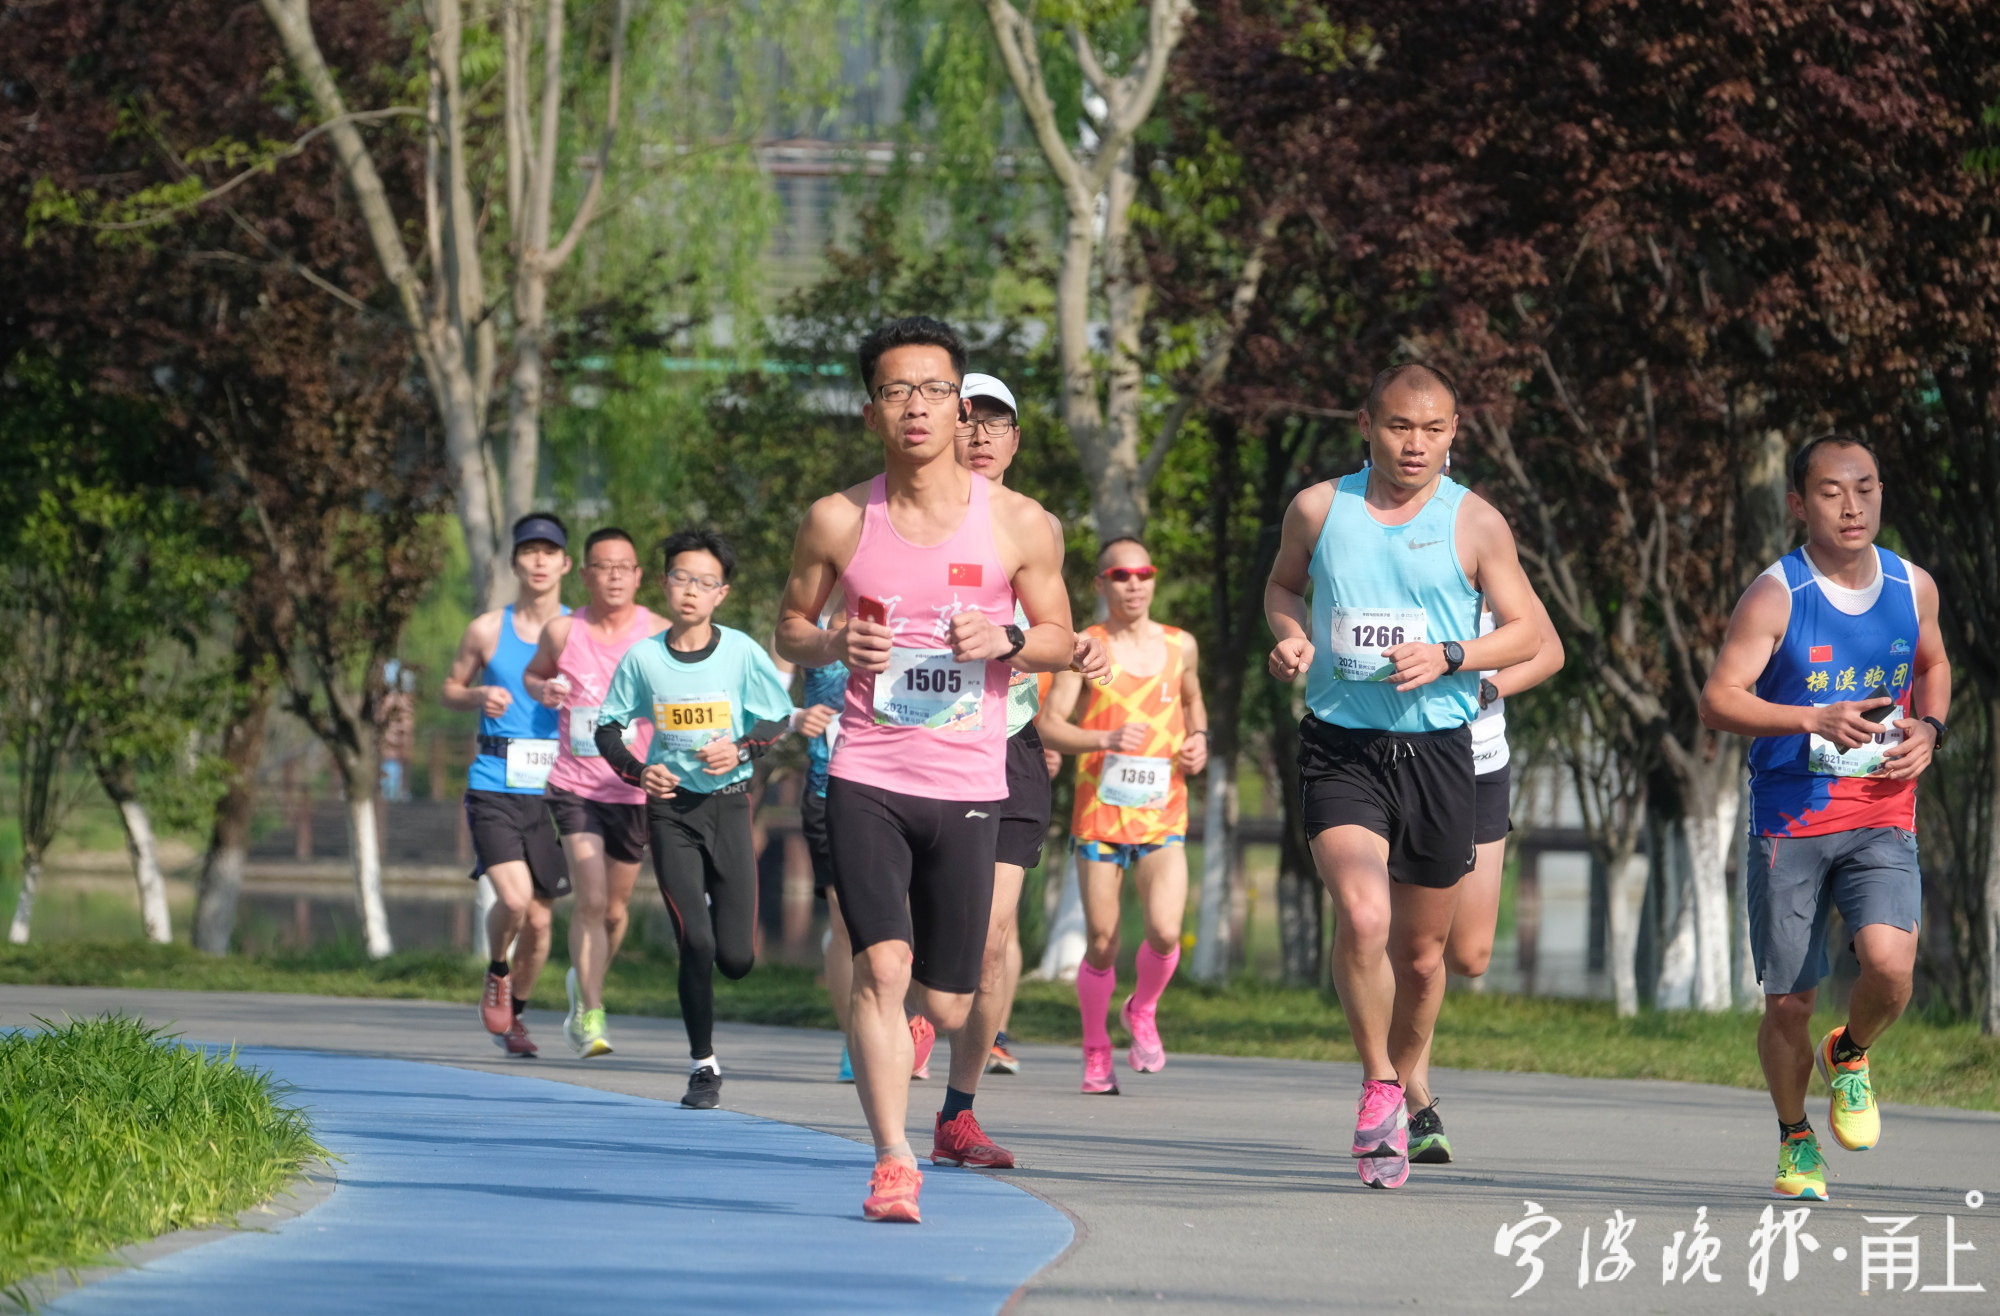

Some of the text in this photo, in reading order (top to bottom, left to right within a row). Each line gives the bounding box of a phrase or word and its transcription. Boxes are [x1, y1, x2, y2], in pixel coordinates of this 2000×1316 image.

[1352, 625, 1405, 647] 1266
[1338, 656, 1357, 669] 2021
[904, 668, 962, 693] 1505
[1804, 662, 1909, 692] 横溪跑团
[671, 707, 714, 726] 5031
[883, 701, 908, 715] 2021
[1818, 753, 1841, 765] 2021
[1120, 768, 1156, 785] 1369
